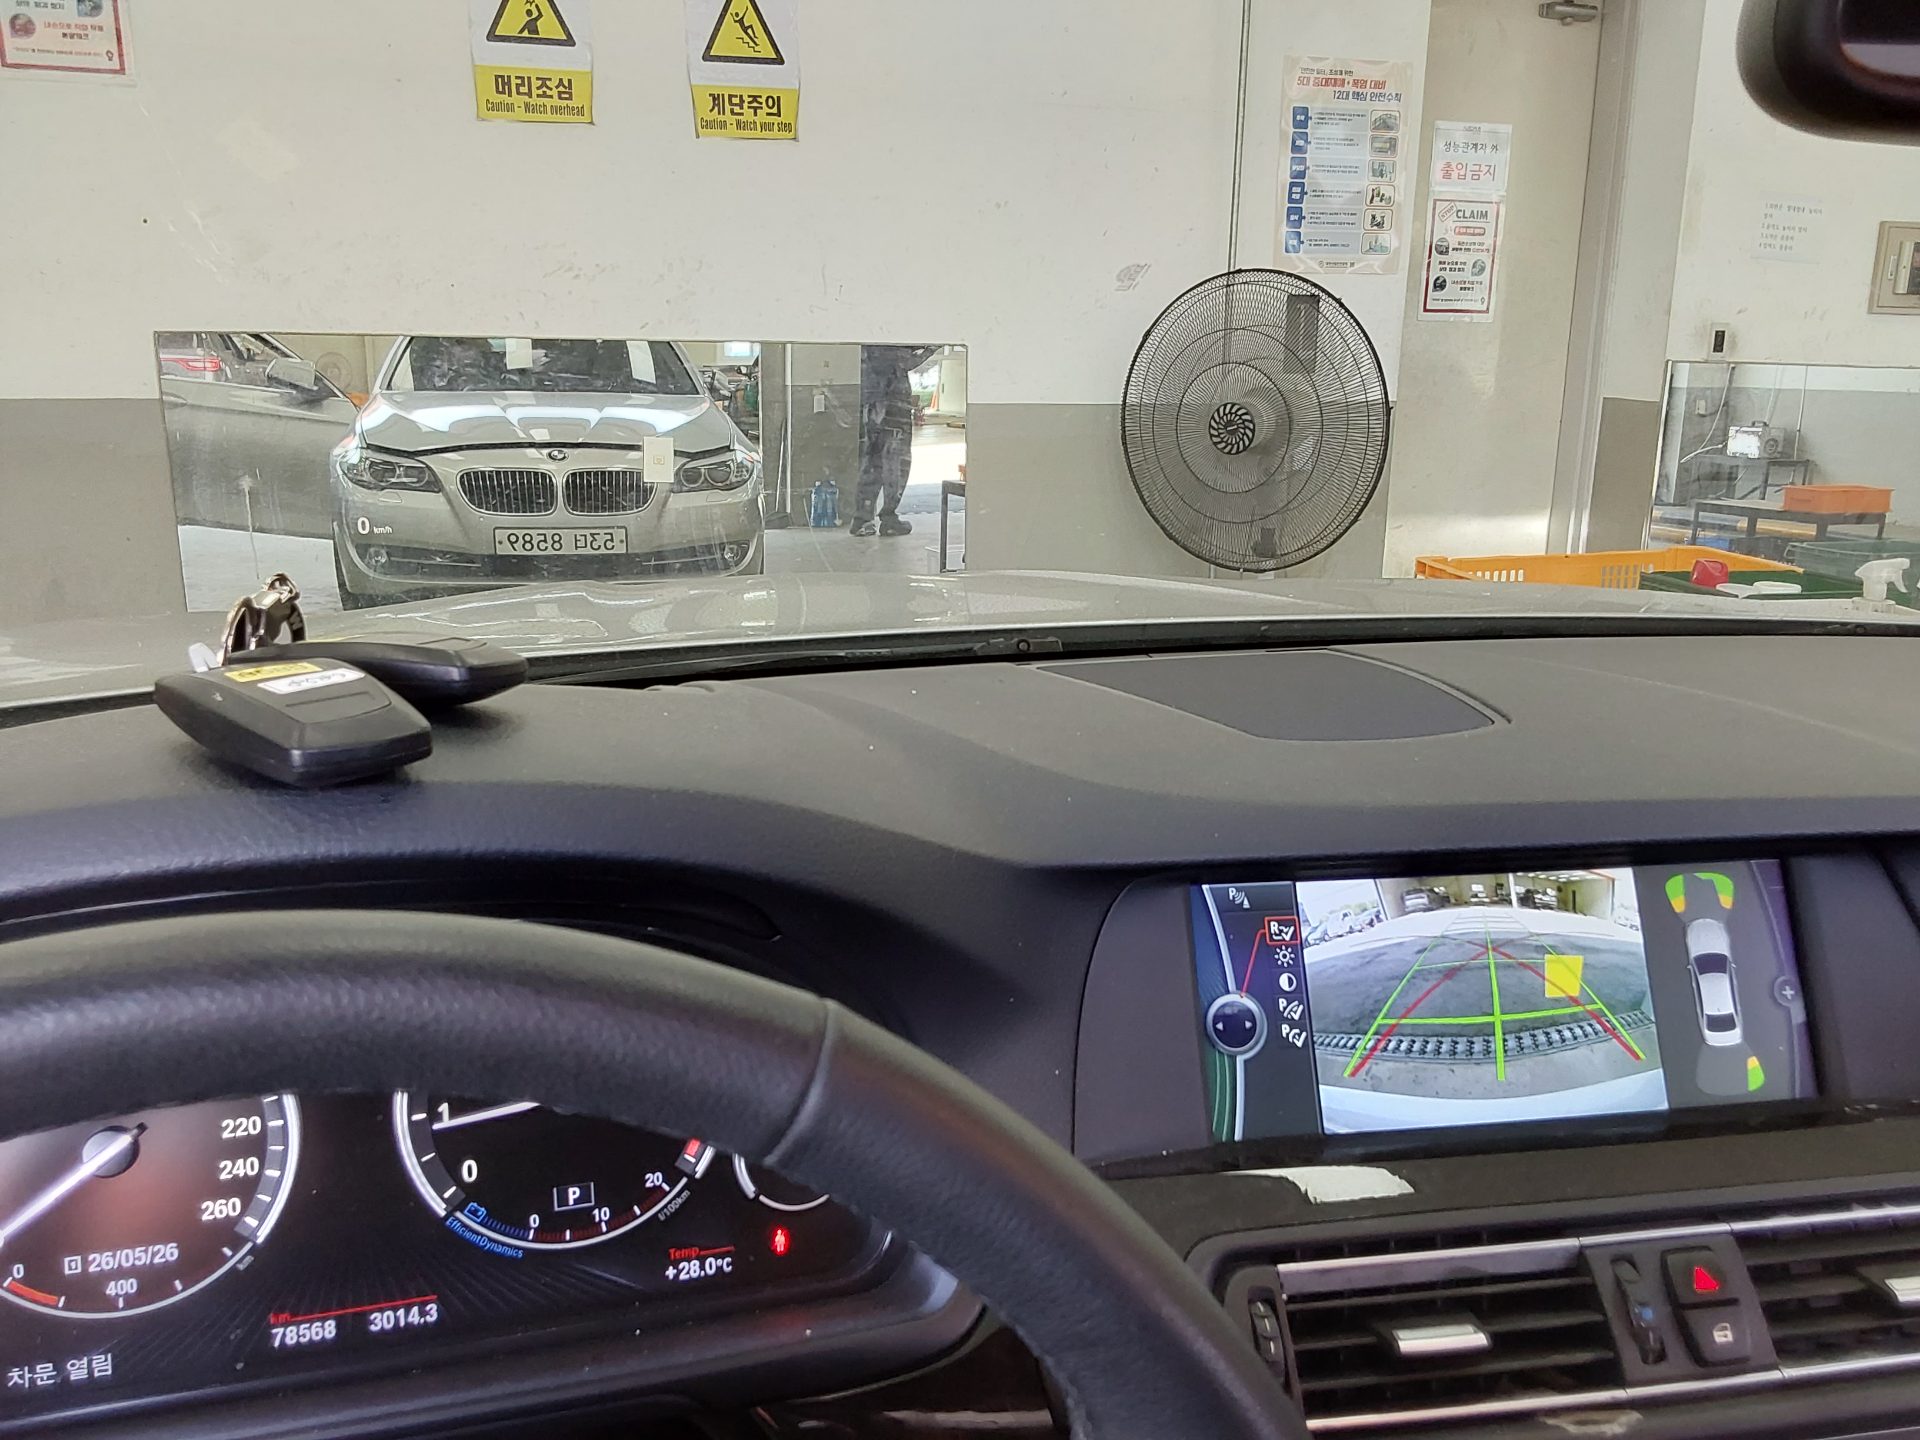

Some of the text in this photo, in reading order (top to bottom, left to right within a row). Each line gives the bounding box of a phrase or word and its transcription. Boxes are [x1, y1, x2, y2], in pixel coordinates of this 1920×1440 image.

[494, 74, 574, 101] 머리조심
[1297, 76, 1310, 86] 5대
[1351, 78, 1368, 89] 폭염
[1369, 79, 1387, 90] 대비
[708, 93, 782, 118] 계단주의
[1333, 90, 1402, 103] 12대 핵심 안전수칙
[485, 98, 515, 113] Caution
[523, 101, 548, 115] Watch
[550, 103, 585, 117] overhead
[700, 117, 728, 130] Caution
[735, 118, 758, 132] Watch
[760, 121, 775, 133] your
[777, 120, 793, 134] step
[1443, 140, 1487, 154] 성능관계자
[1440, 161, 1497, 182] 출입금지
[1455, 209, 1488, 220] CLAIM
[357, 516, 370, 534] 0
[437, 1102, 450, 1123] 1
[221, 1115, 262, 1139] 220
[218, 1156, 260, 1180] 240
[462, 1159, 478, 1183] 0
[644, 1171, 663, 1188] 20
[567, 1186, 581, 1206] P
[201, 1197, 242, 1221] 260
[592, 1206, 610, 1223] 10
[529, 1213, 540, 1228] 0
[446, 1216, 524, 1259] EfficientDynamics
[87, 1242, 179, 1273] 26/05/26
[668, 1246, 700, 1260] Temp
[12, 1263, 25, 1279] 0
[105, 1278, 138, 1296] 400
[270, 1312, 291, 1325] km
[271, 1303, 439, 1348] 78568 3014.3
[7, 1352, 112, 1388] 차문 열림
